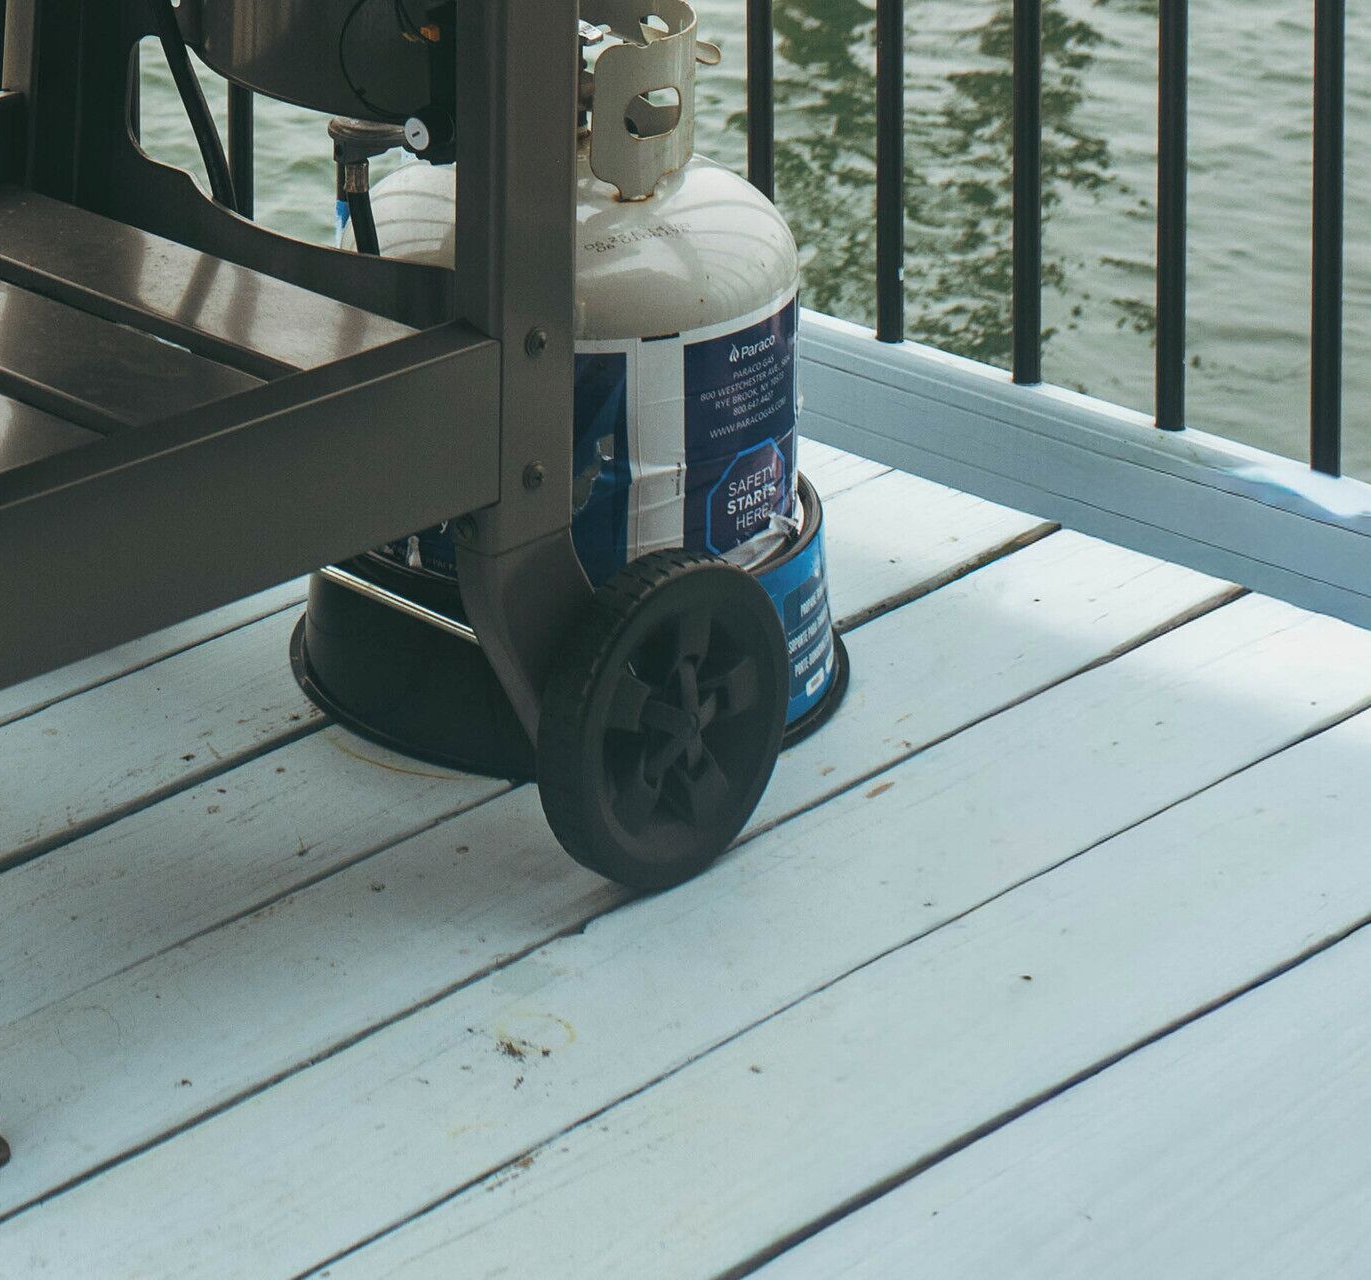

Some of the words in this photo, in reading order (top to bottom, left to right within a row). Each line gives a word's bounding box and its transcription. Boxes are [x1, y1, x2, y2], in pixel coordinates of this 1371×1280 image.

[741, 334, 775, 359] Paraco
[733, 361, 762, 380] PARACO
[762, 354, 774, 368] GAS
[700, 390, 716, 402] 800
[718, 372, 767, 398] WESTCHESTER
[715, 396, 731, 410] RYE
[760, 381, 769, 392] NY
[728, 464, 775, 497] SAFETY
